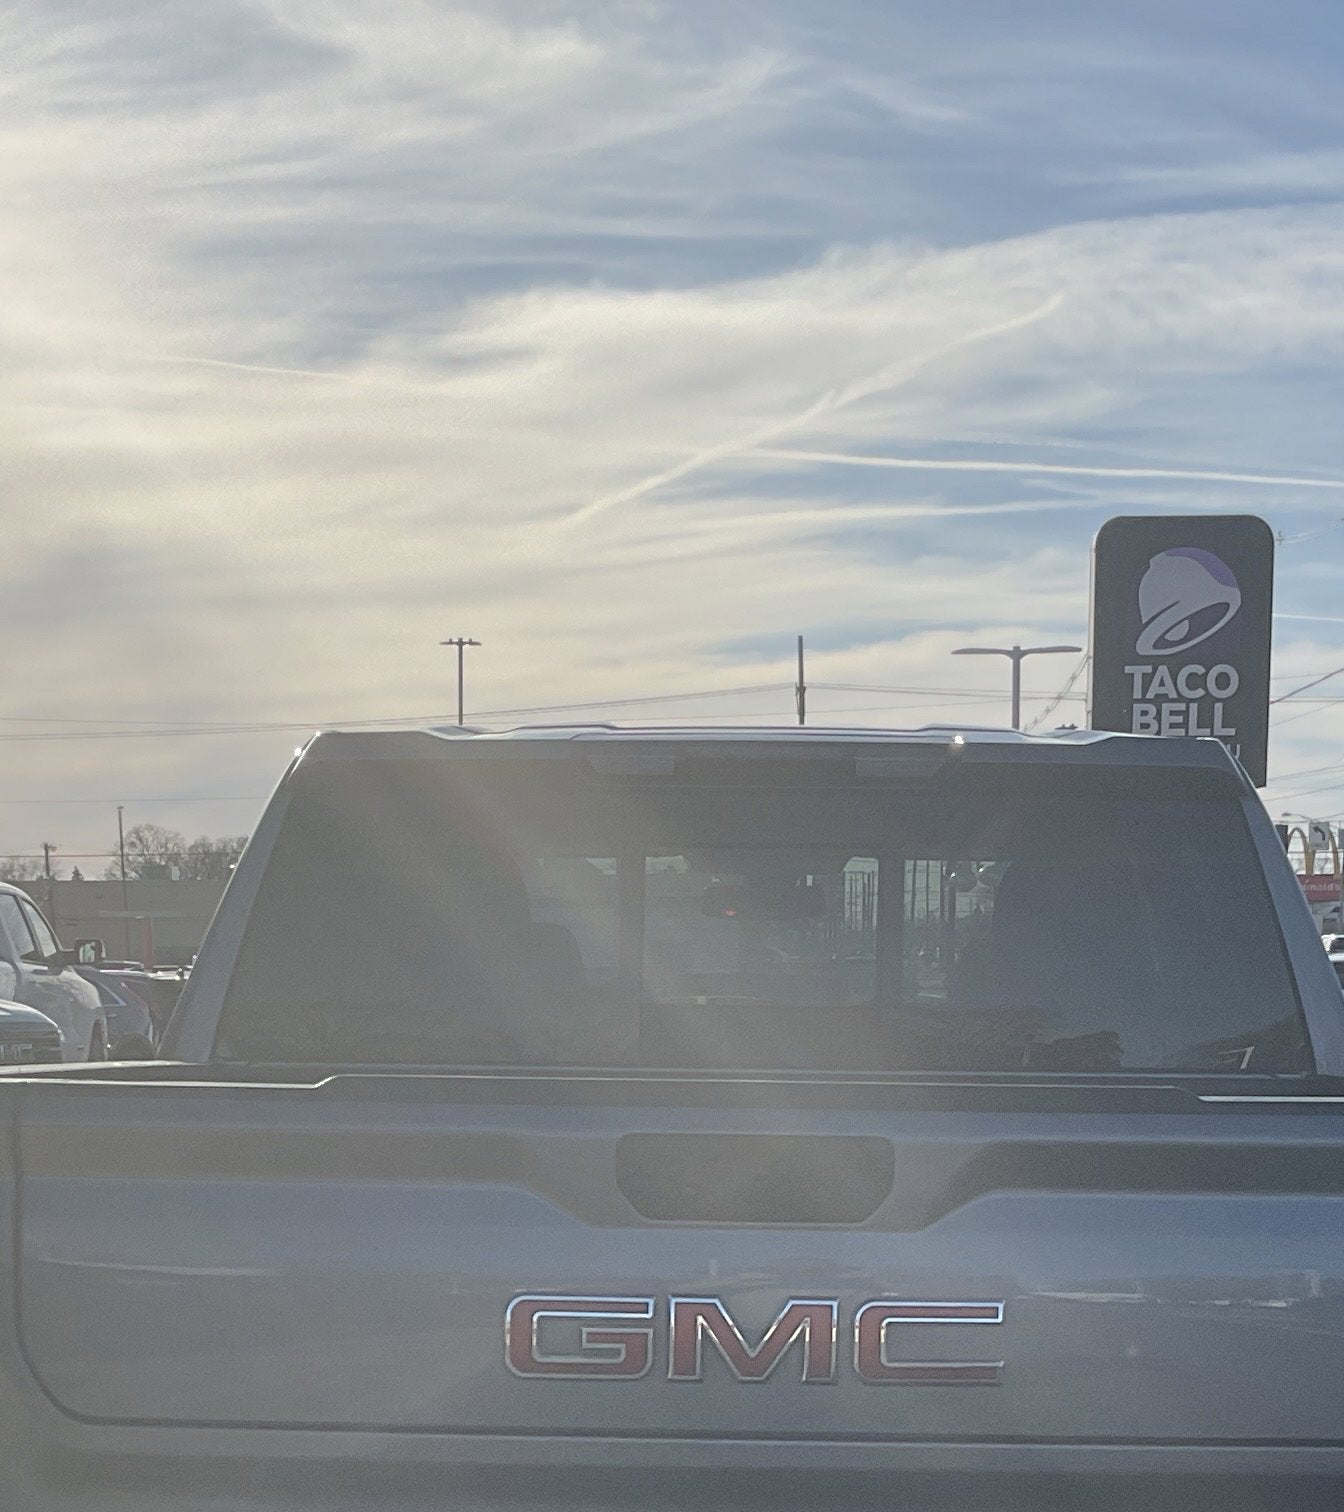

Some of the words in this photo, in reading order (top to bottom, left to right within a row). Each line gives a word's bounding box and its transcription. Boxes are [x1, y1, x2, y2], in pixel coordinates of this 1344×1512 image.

[1124, 664, 1239, 699] TACO
[1132, 702, 1236, 736] BELL
[504, 1294, 1006, 1383] GMC
